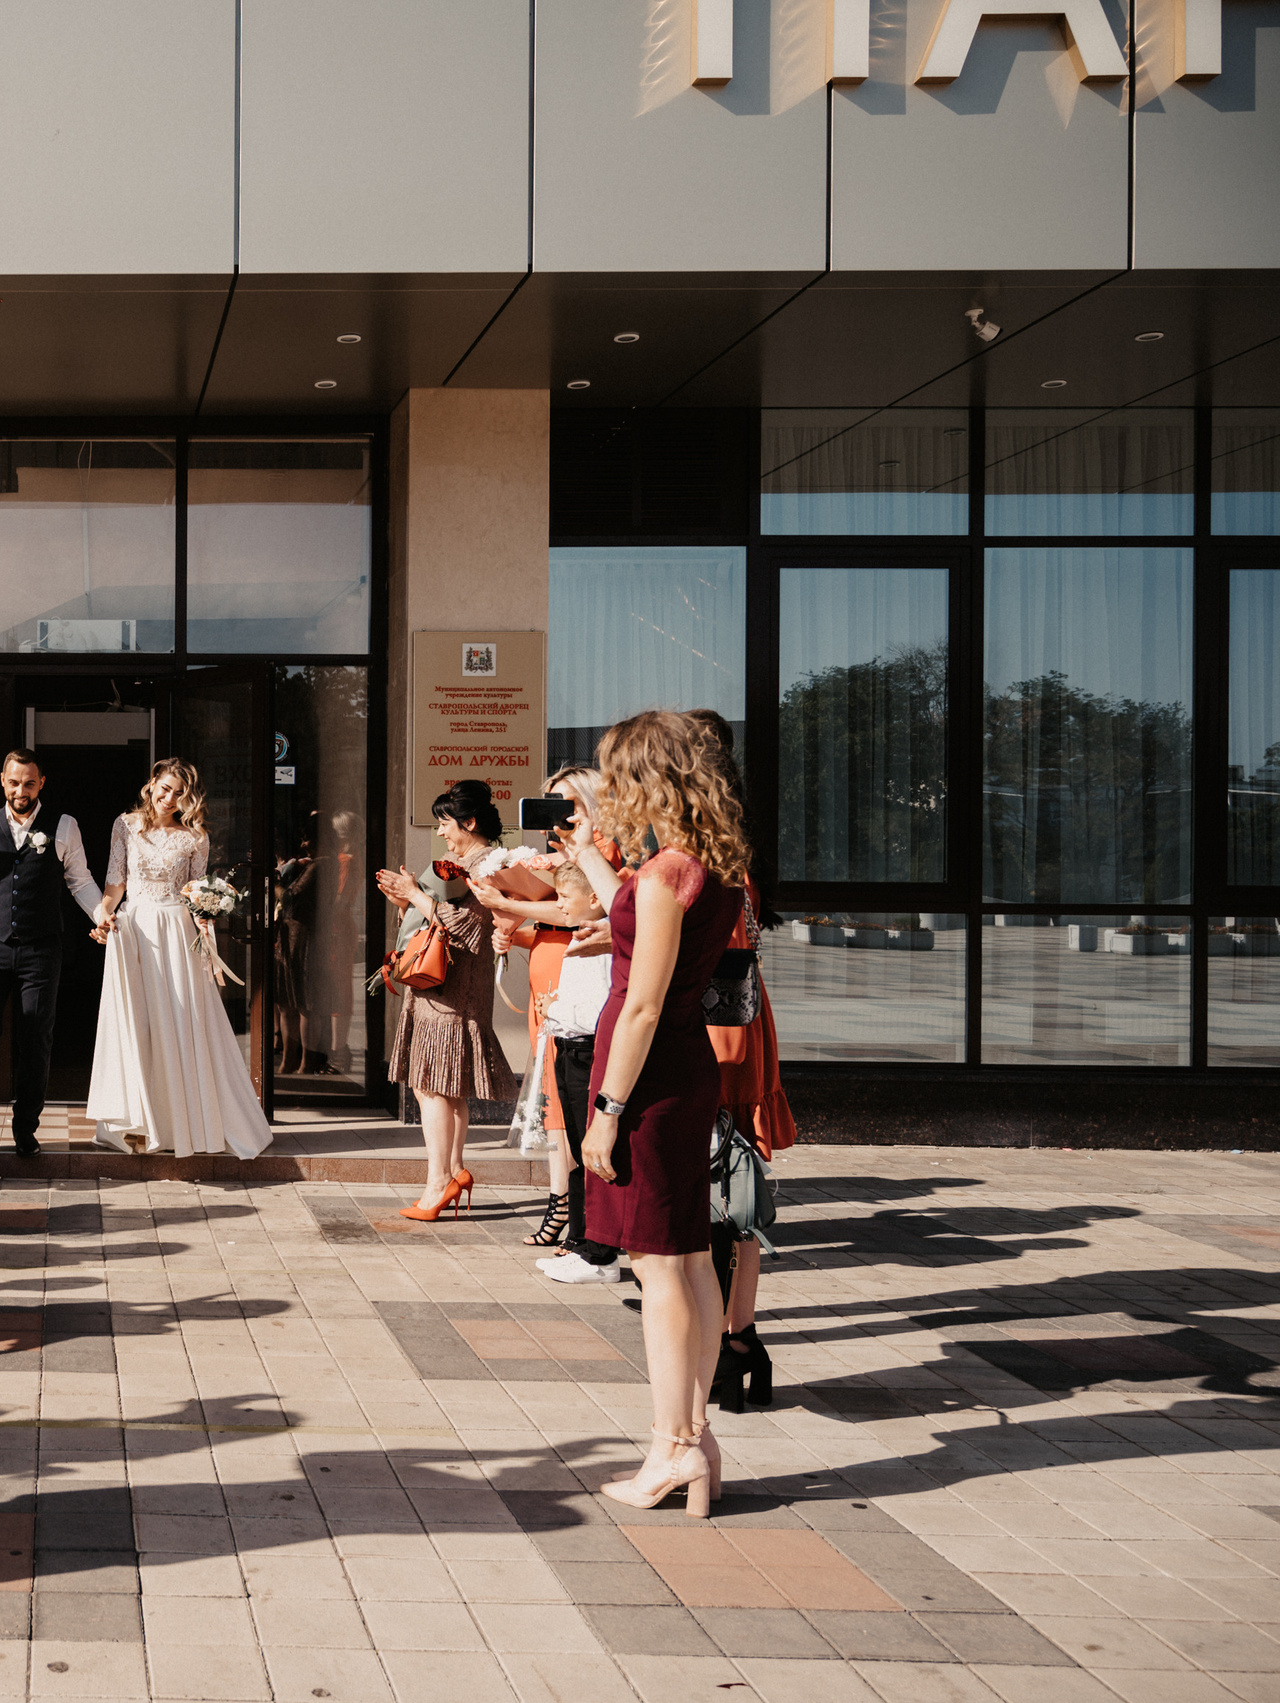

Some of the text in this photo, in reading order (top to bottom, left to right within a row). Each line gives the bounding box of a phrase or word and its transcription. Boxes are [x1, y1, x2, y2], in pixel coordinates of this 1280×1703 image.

[434, 685, 484, 693] Муниципальное
[428, 702, 499, 710] СТАВРОПОЛЬСКИЙ
[468, 720, 508, 728] Ставрополь,
[428, 754, 529, 766] ДОМ ДРУЖБЫ
